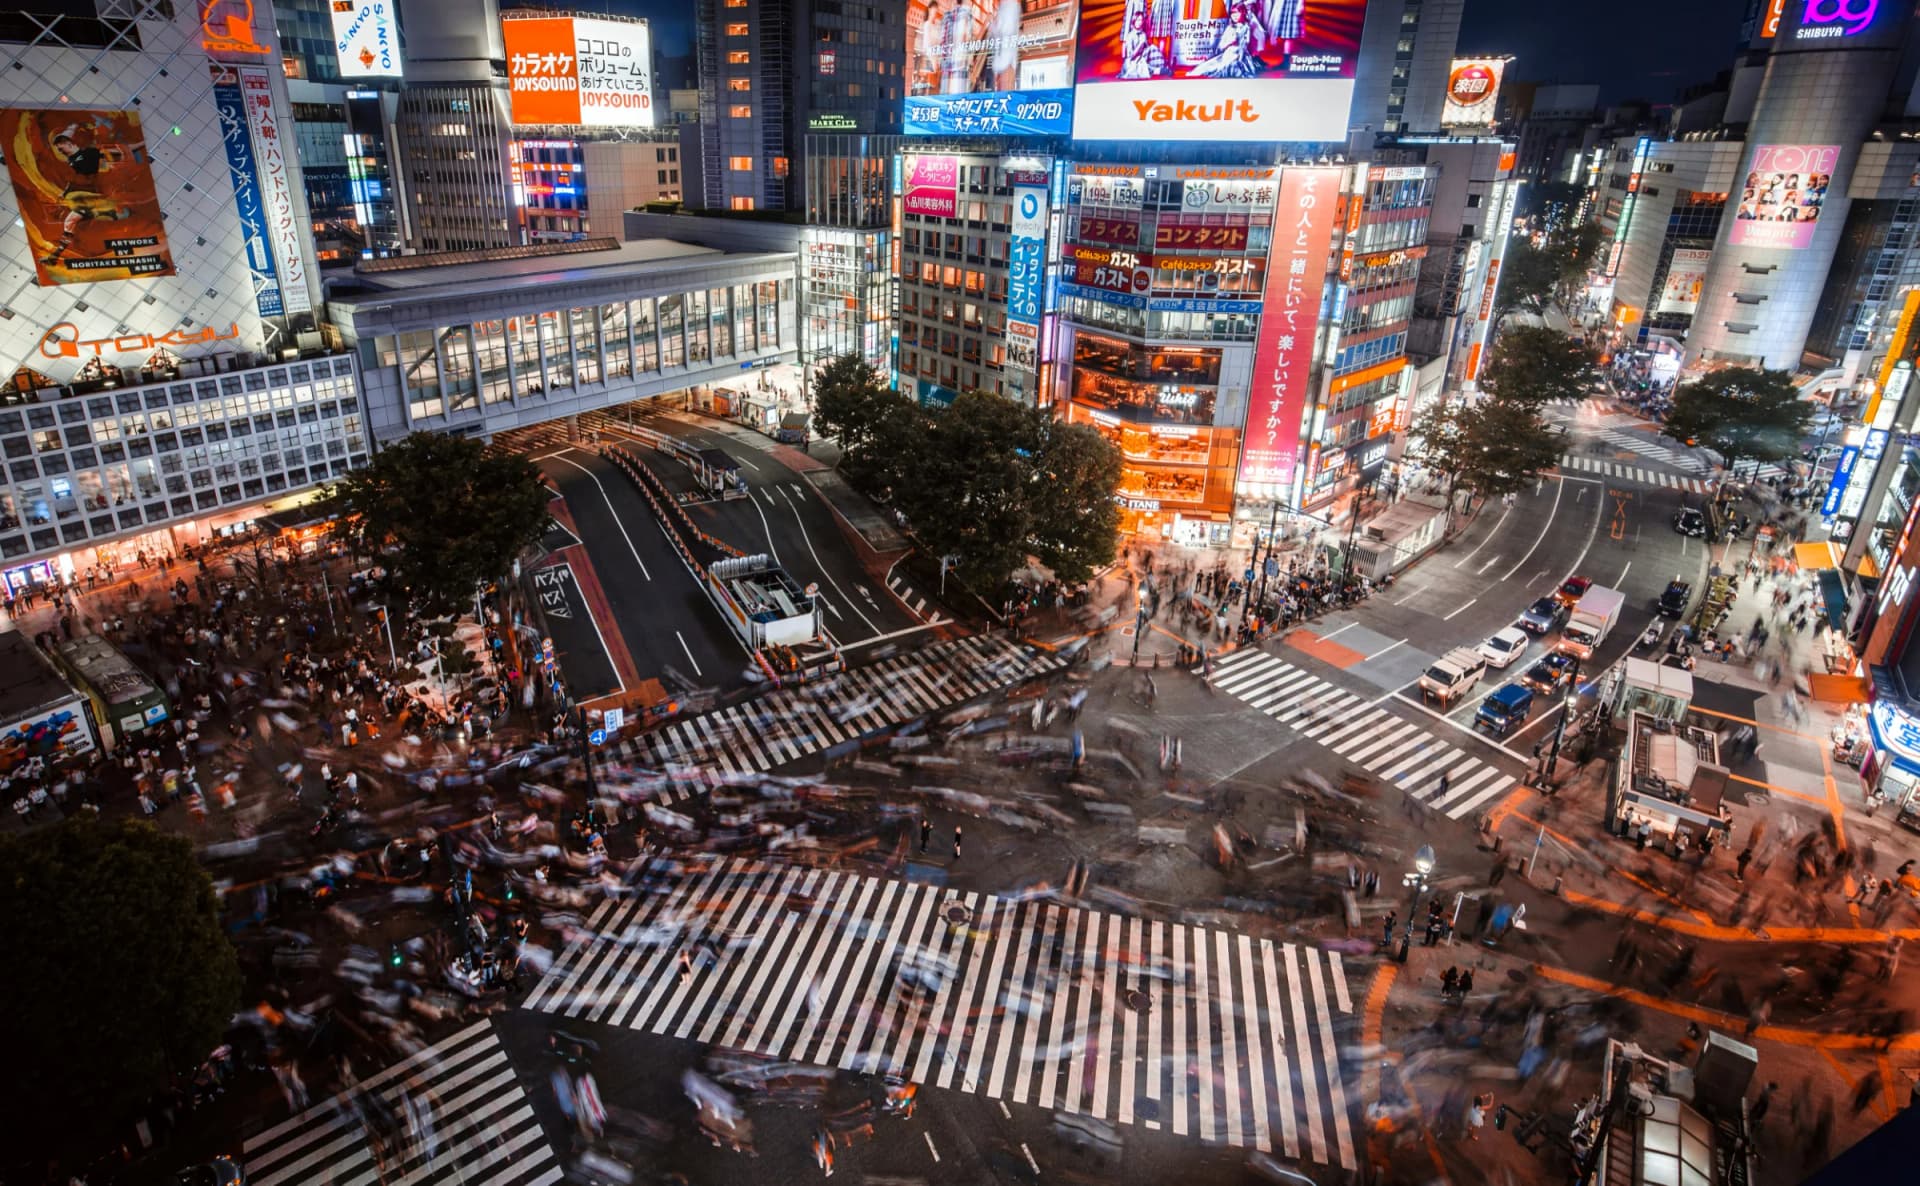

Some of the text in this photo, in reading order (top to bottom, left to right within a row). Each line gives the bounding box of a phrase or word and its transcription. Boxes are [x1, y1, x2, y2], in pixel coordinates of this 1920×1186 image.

[339, 6, 370, 53] SANKYO
[1176, 20, 1225, 31] Tough-Ma
[1796, 27, 1844, 39] SHIBUYA
[373, 3, 392, 69] SANKYO
[577, 38, 632, 57] ココロの
[511, 52, 574, 75] カラオケ
[579, 57, 648, 77] ボリューム、
[1290, 64, 1326, 72] Refresh
[1291, 55, 1342, 65] Tough-Man
[513, 77, 577, 92] JOYSOUND
[581, 77, 649, 92] あげていこう。
[1454, 78, 1488, 93] 楽園
[582, 91, 650, 109] JOYSOUND
[946, 95, 1012, 115] スプリンターズ
[1132, 98, 1260, 123] Yakult
[954, 116, 1001, 132] ステークス
[1070, 183, 1081, 195] 9F
[1214, 185, 1273, 204] しゃぶ葉
[910, 196, 953, 213] 品川美容外科
[111, 238, 155, 247] ARTWORK
[1156, 227, 1244, 245] コンタクト
[71, 256, 156, 269] NORITAKE KINASHI
[1110, 251, 1140, 268] ガスト
[1213, 258, 1256, 274] ガスト
[1063, 264, 1077, 276] 7F
[1094, 267, 1129, 288] ガスト
[80, 324, 239, 355] TOKYU
